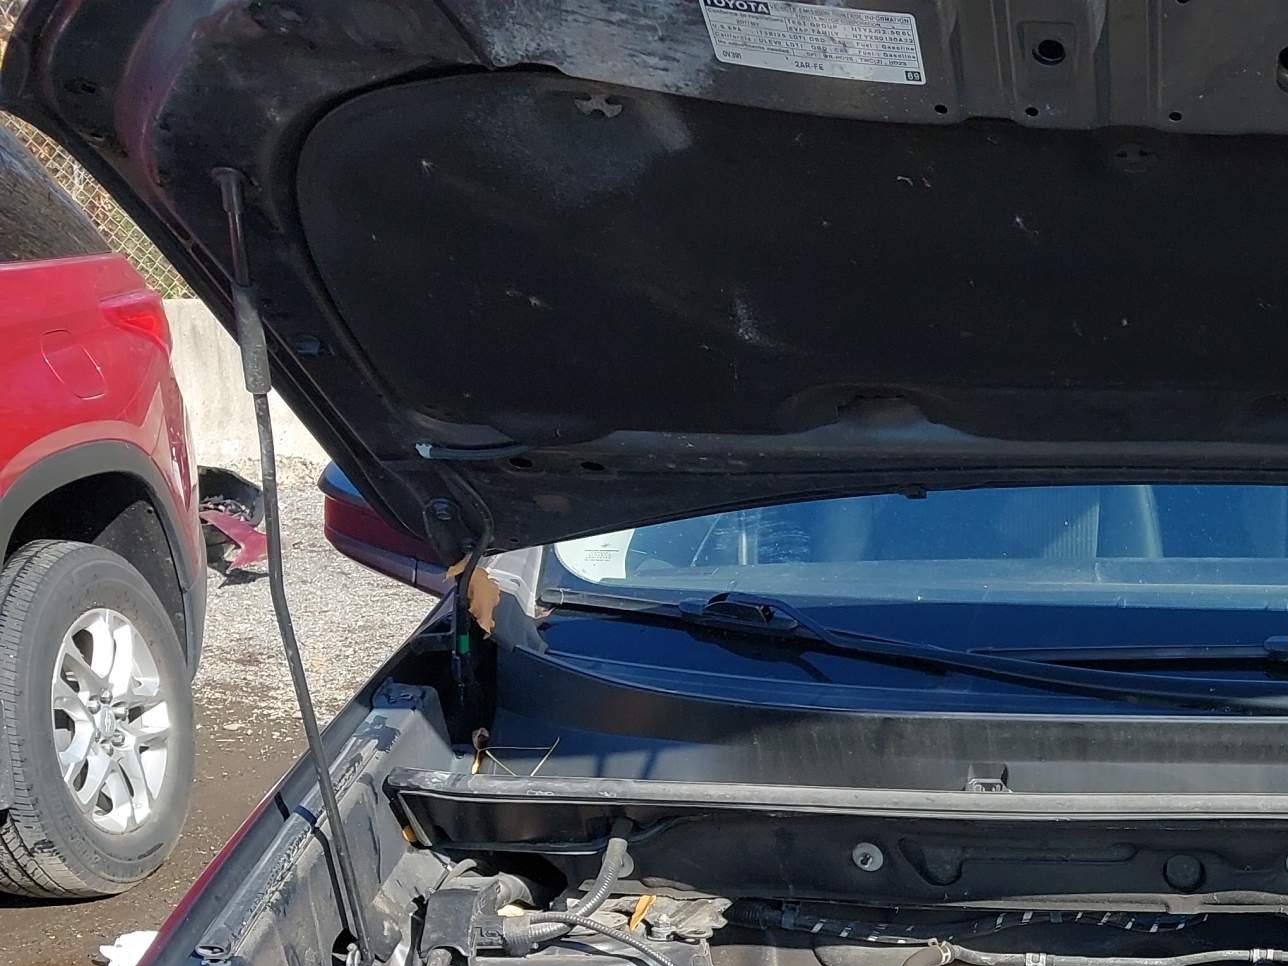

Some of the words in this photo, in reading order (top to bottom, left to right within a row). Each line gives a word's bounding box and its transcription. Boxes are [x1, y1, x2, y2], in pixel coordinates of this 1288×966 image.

[705, 0, 769, 13] TOYOTA
[881, 44, 915, 52] Gasoline
[883, 52, 916, 60] Gasoline
[794, 61, 825, 71] 2AR-FE
